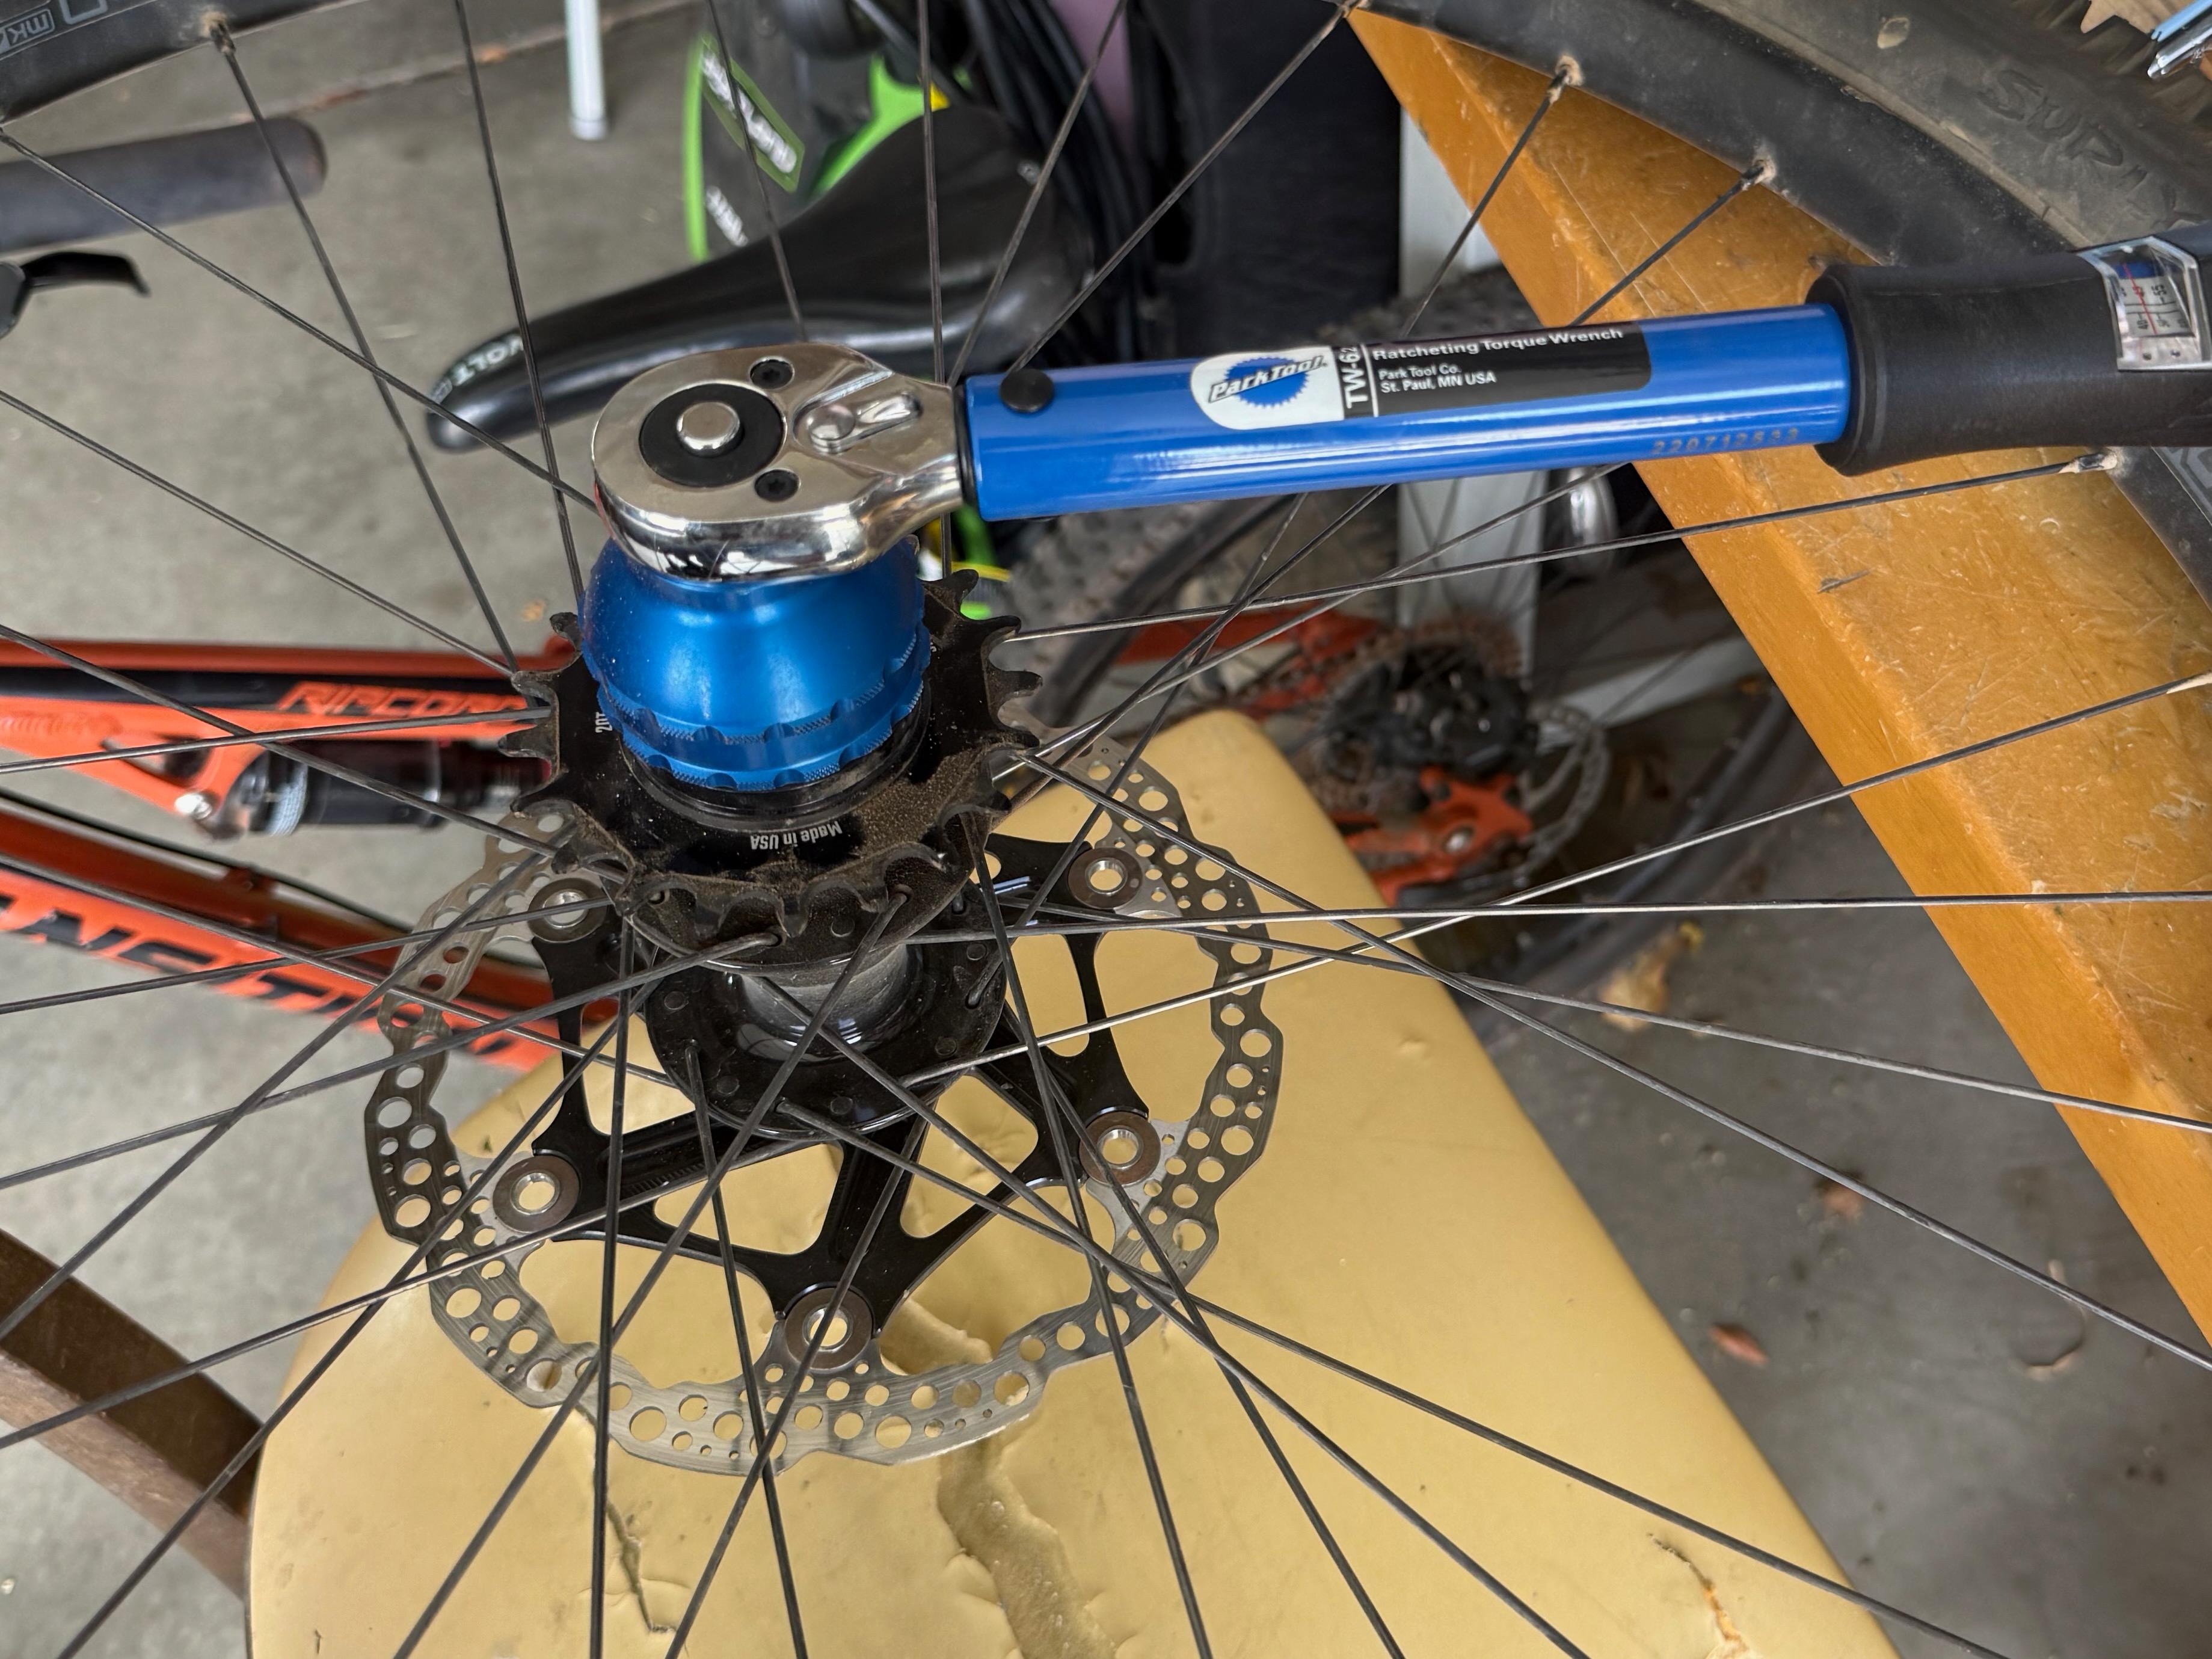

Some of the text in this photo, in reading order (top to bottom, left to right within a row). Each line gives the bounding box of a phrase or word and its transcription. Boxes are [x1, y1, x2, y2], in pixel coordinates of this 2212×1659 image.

[1372, 328, 1624, 360] Ratcheting Torque Wrench
[1339, 346, 1369, 409] TW-62
[1378, 363, 1462, 380] Park Tool Co.
[1380, 371, 1497, 393] St. Paul, MN USA
[750, 820, 843, 850] Made in USA
